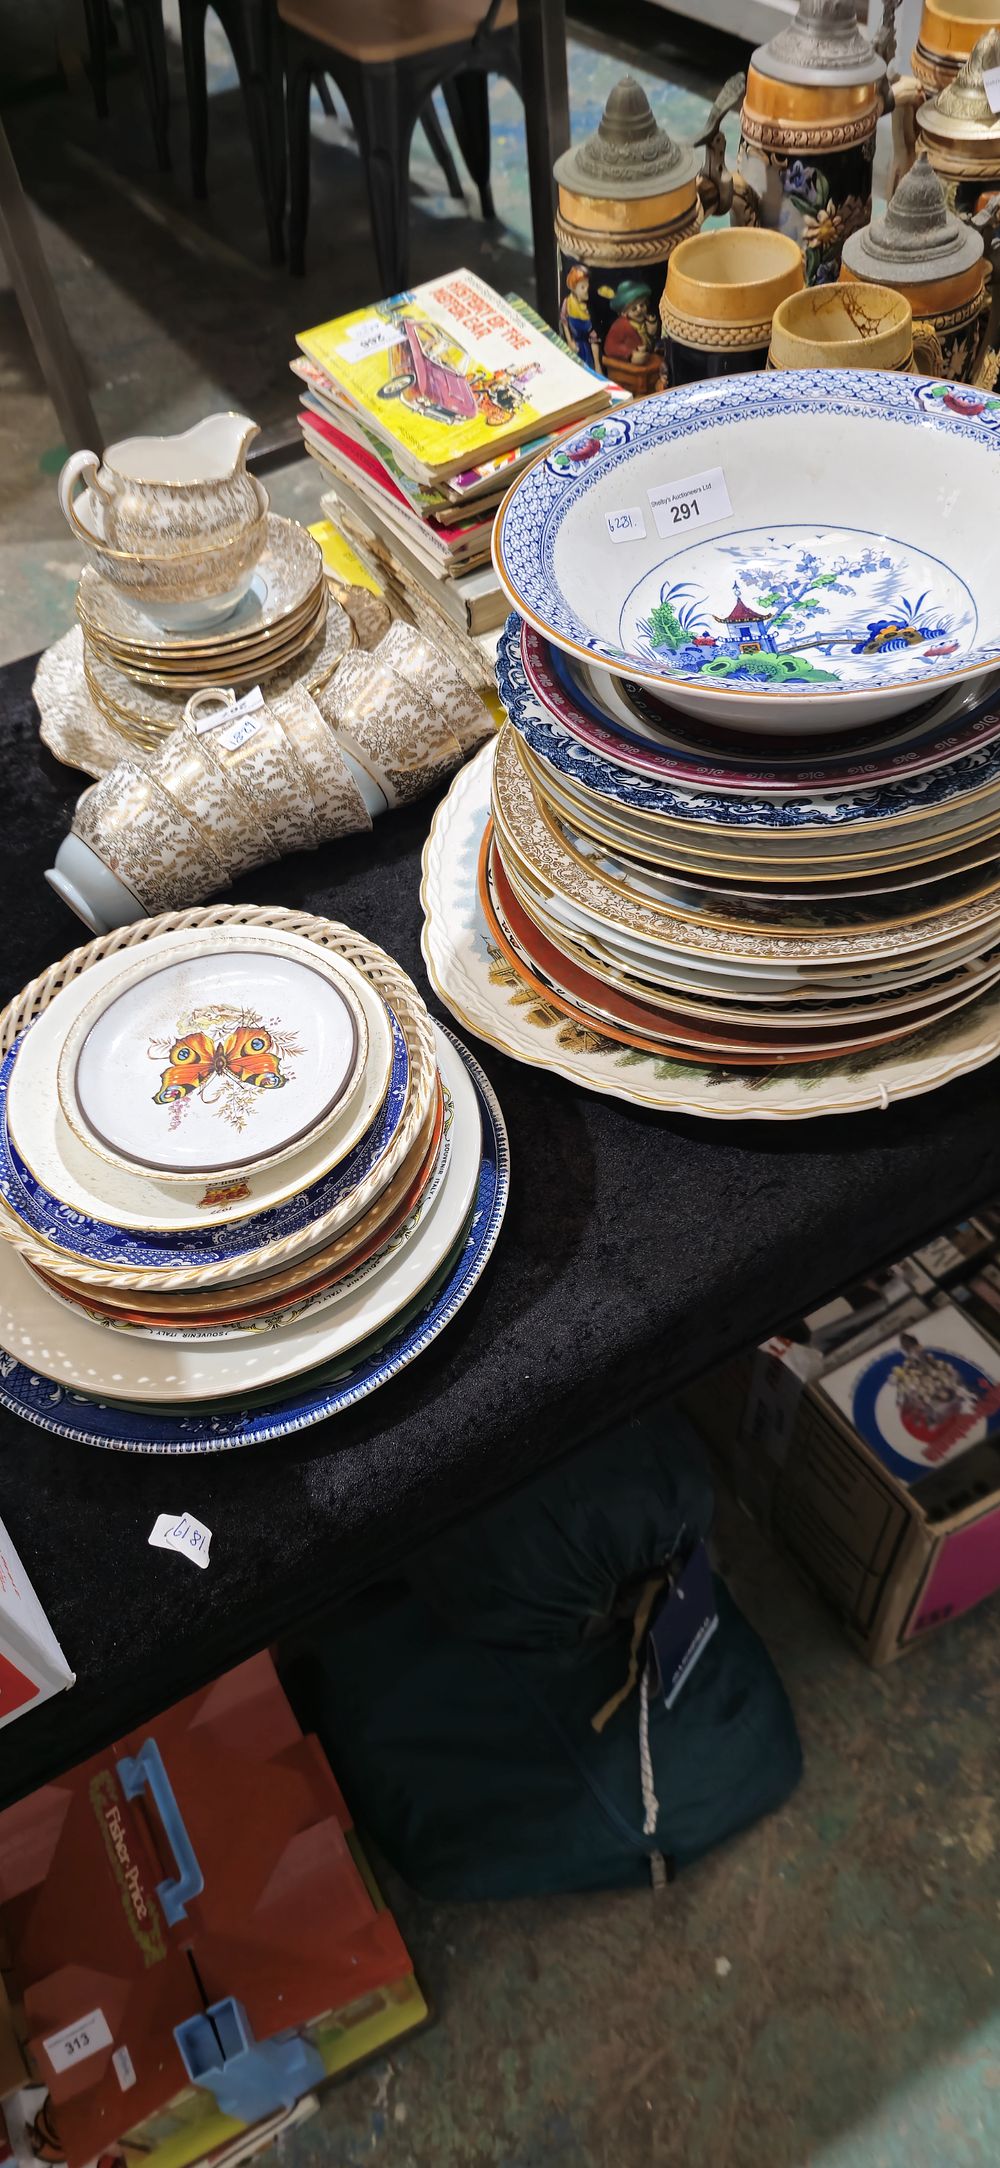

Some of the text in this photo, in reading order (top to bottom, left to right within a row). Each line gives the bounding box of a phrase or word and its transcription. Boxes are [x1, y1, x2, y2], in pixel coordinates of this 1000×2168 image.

[462, 317, 493, 341] CAR
[487, 311, 510, 329] OF
[501, 326, 532, 351] THE
[671, 486, 702, 501] Auctioneers
[702, 482, 712, 491] Ltd
[670, 499, 700, 523] 291
[429, 1143, 451, 1195] SOUVENIR ITALY
[323, 1260, 381, 1301] SOUVENIR ITALY
[65, 2032, 90, 2055] 313
